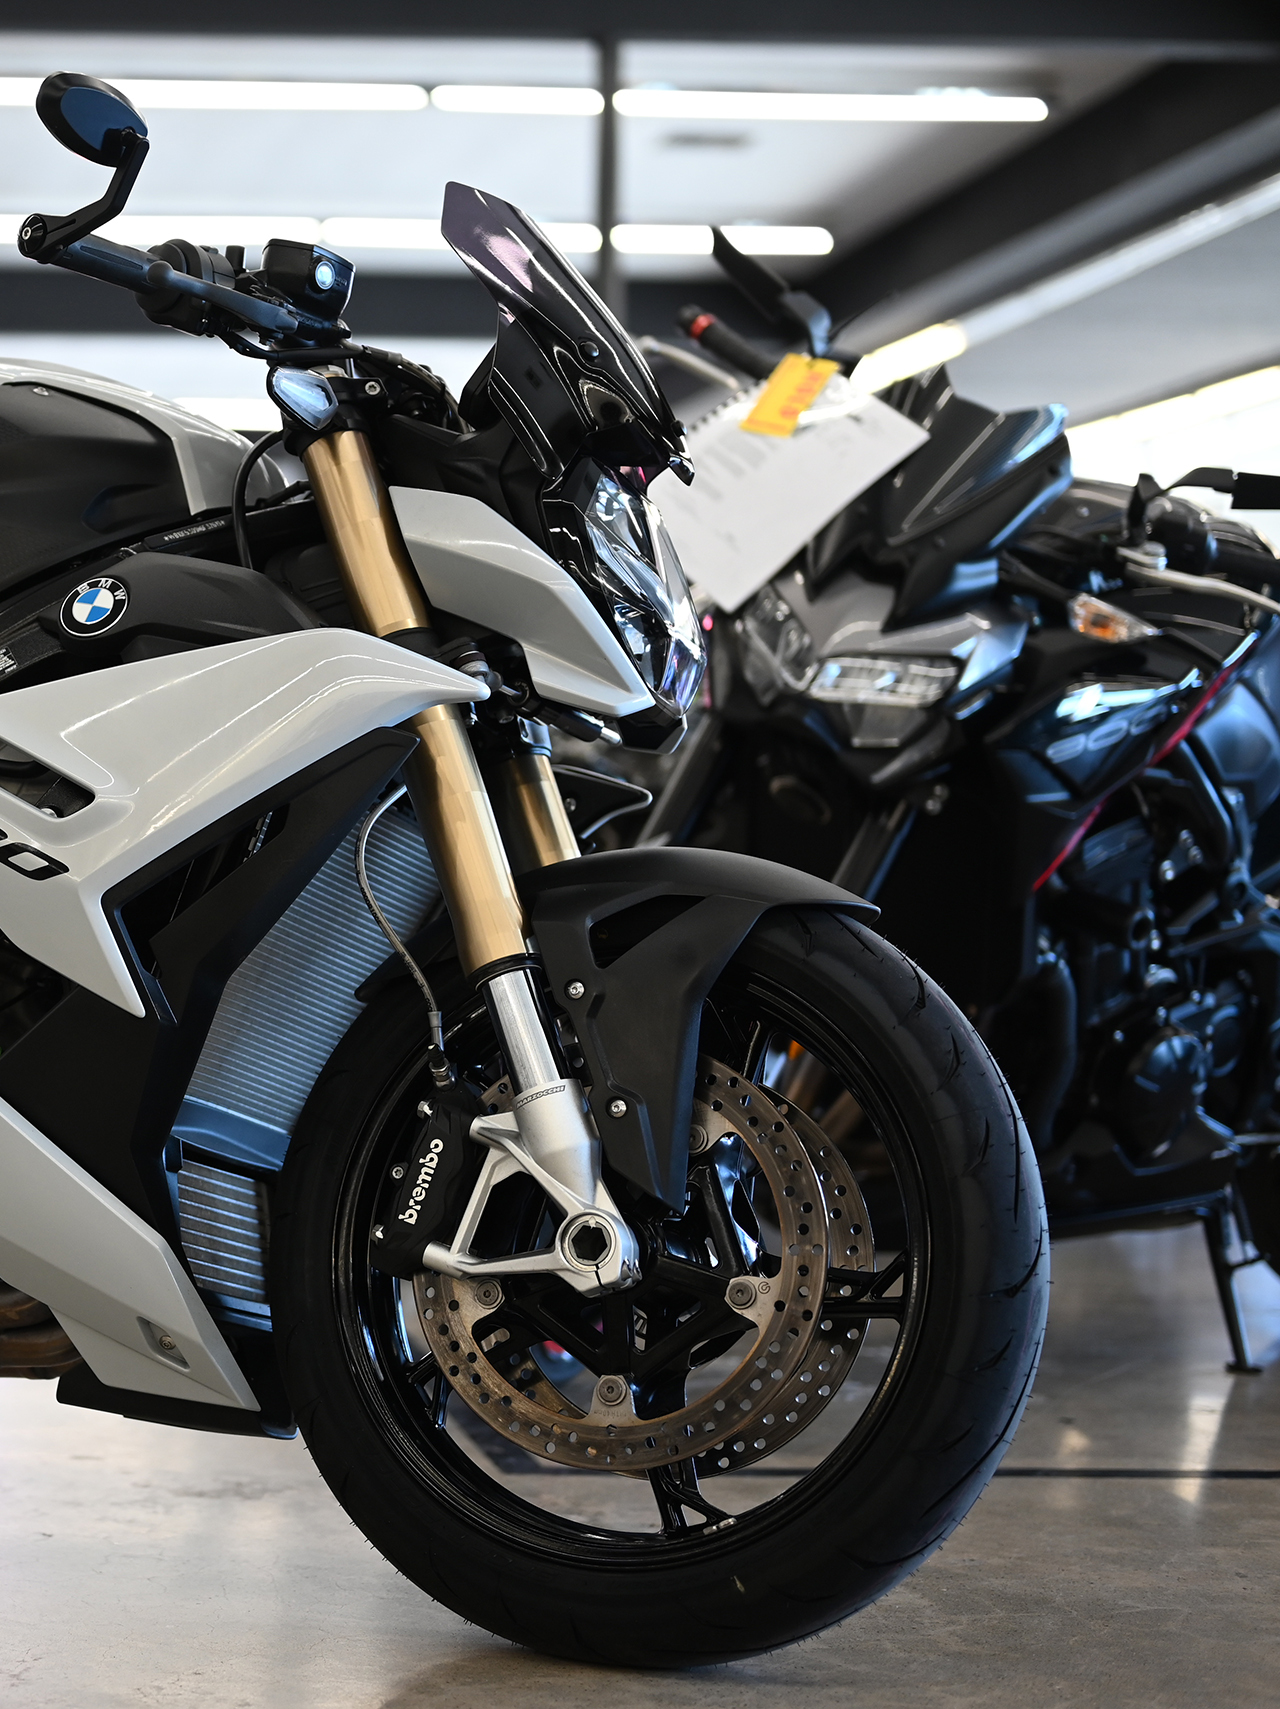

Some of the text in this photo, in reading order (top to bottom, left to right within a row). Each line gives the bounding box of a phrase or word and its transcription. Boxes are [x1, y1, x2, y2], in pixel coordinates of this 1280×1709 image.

[77, 579, 126, 600] BMW
[516, 1085, 566, 1110] MARZOCCHI
[398, 1138, 444, 1225] brembo
